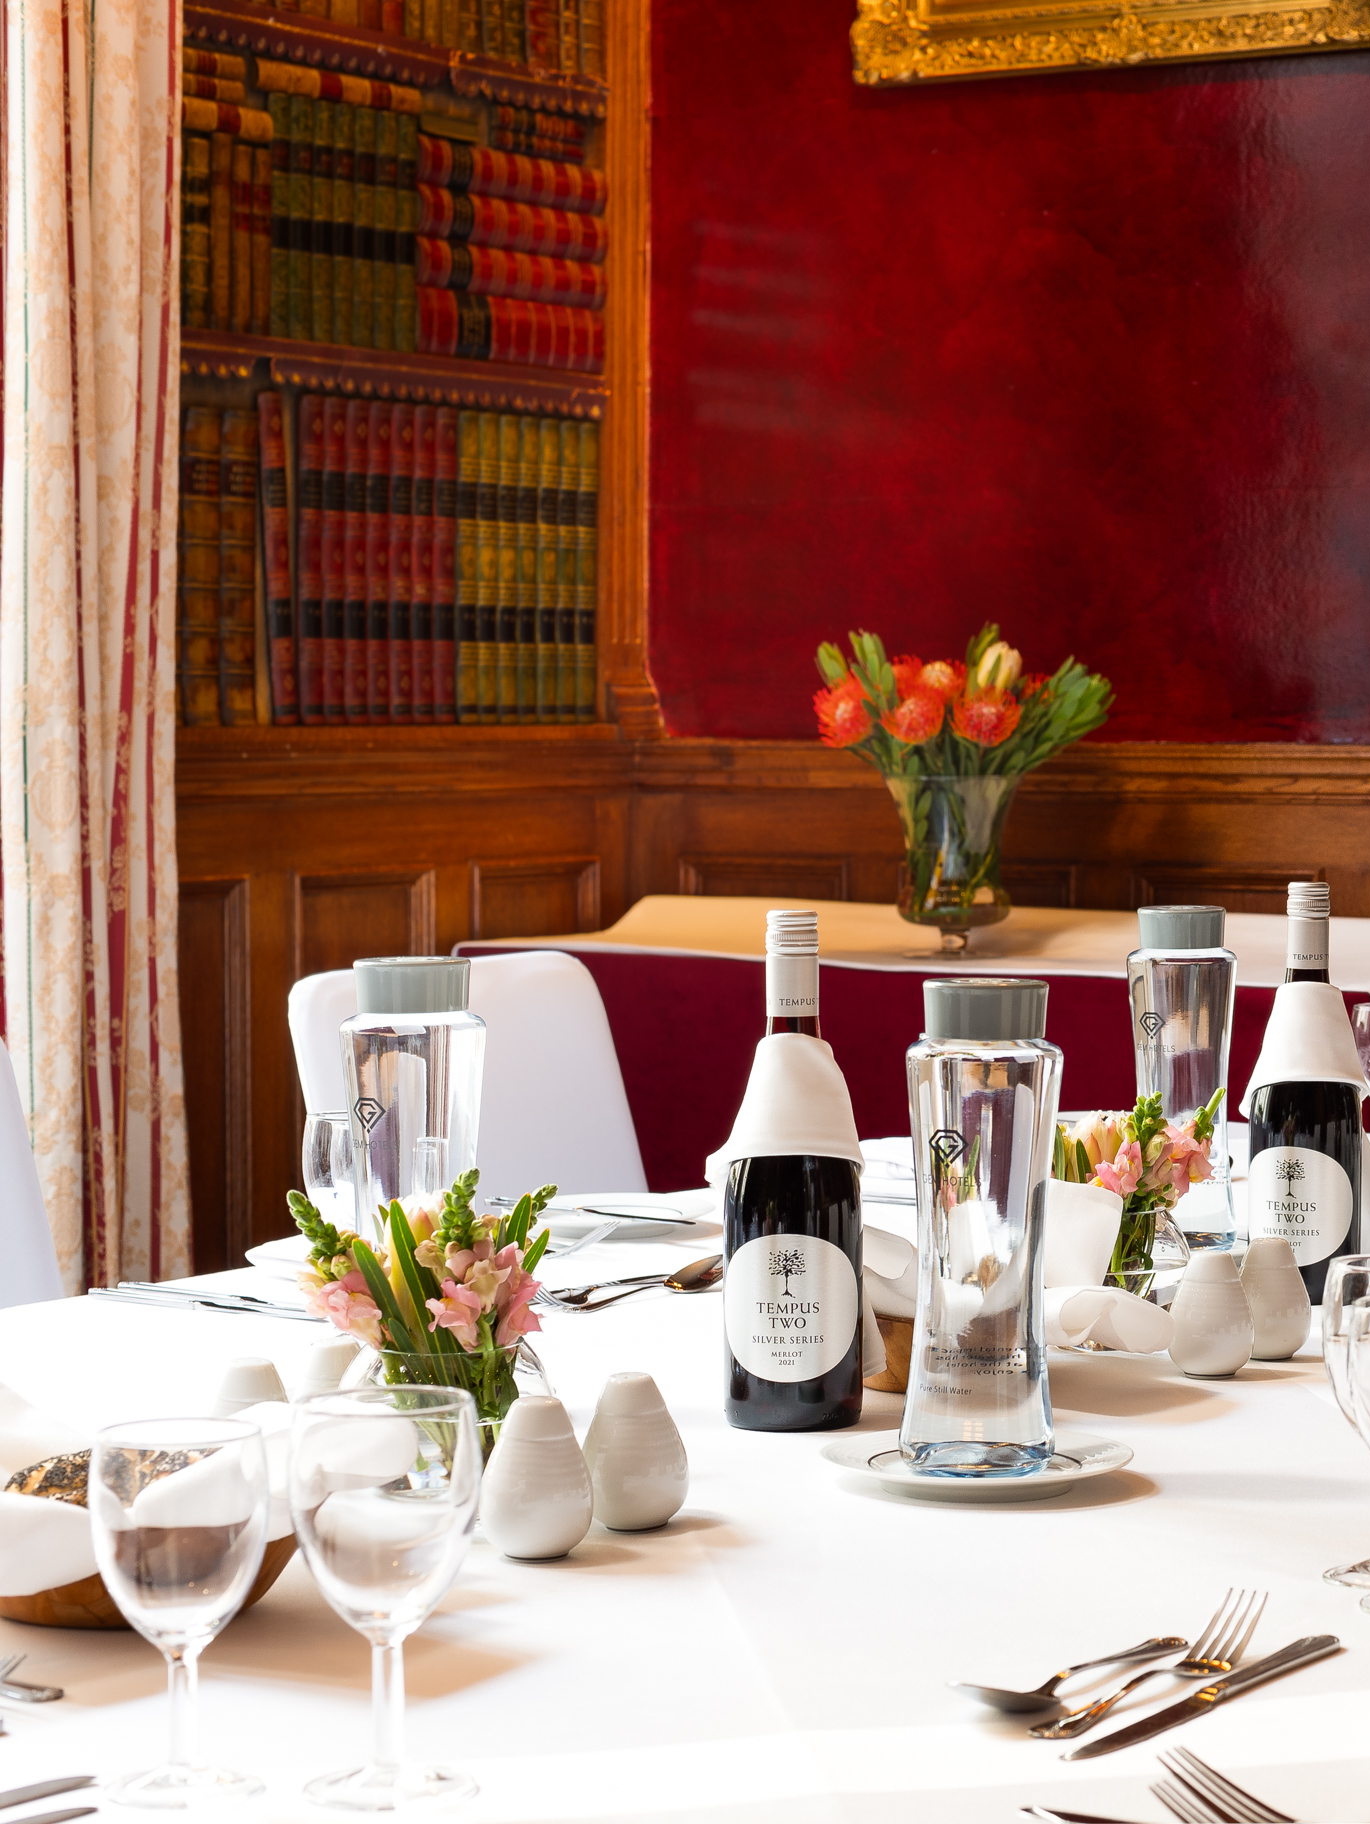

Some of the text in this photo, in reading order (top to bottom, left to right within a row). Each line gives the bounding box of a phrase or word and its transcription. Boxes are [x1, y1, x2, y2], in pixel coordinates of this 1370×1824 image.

[779, 998, 816, 1006] TEMPUS
[1266, 1201, 1317, 1212] TEMPUS
[1275, 1213, 1305, 1224] TWO
[1263, 1227, 1288, 1236] SILVER
[756, 1302, 820, 1314] TEMPUS
[769, 1317, 806, 1329] TWO
[752, 1335, 824, 1344] SILVER SERIES
[920, 1383, 972, 1395] Pure Still Water
